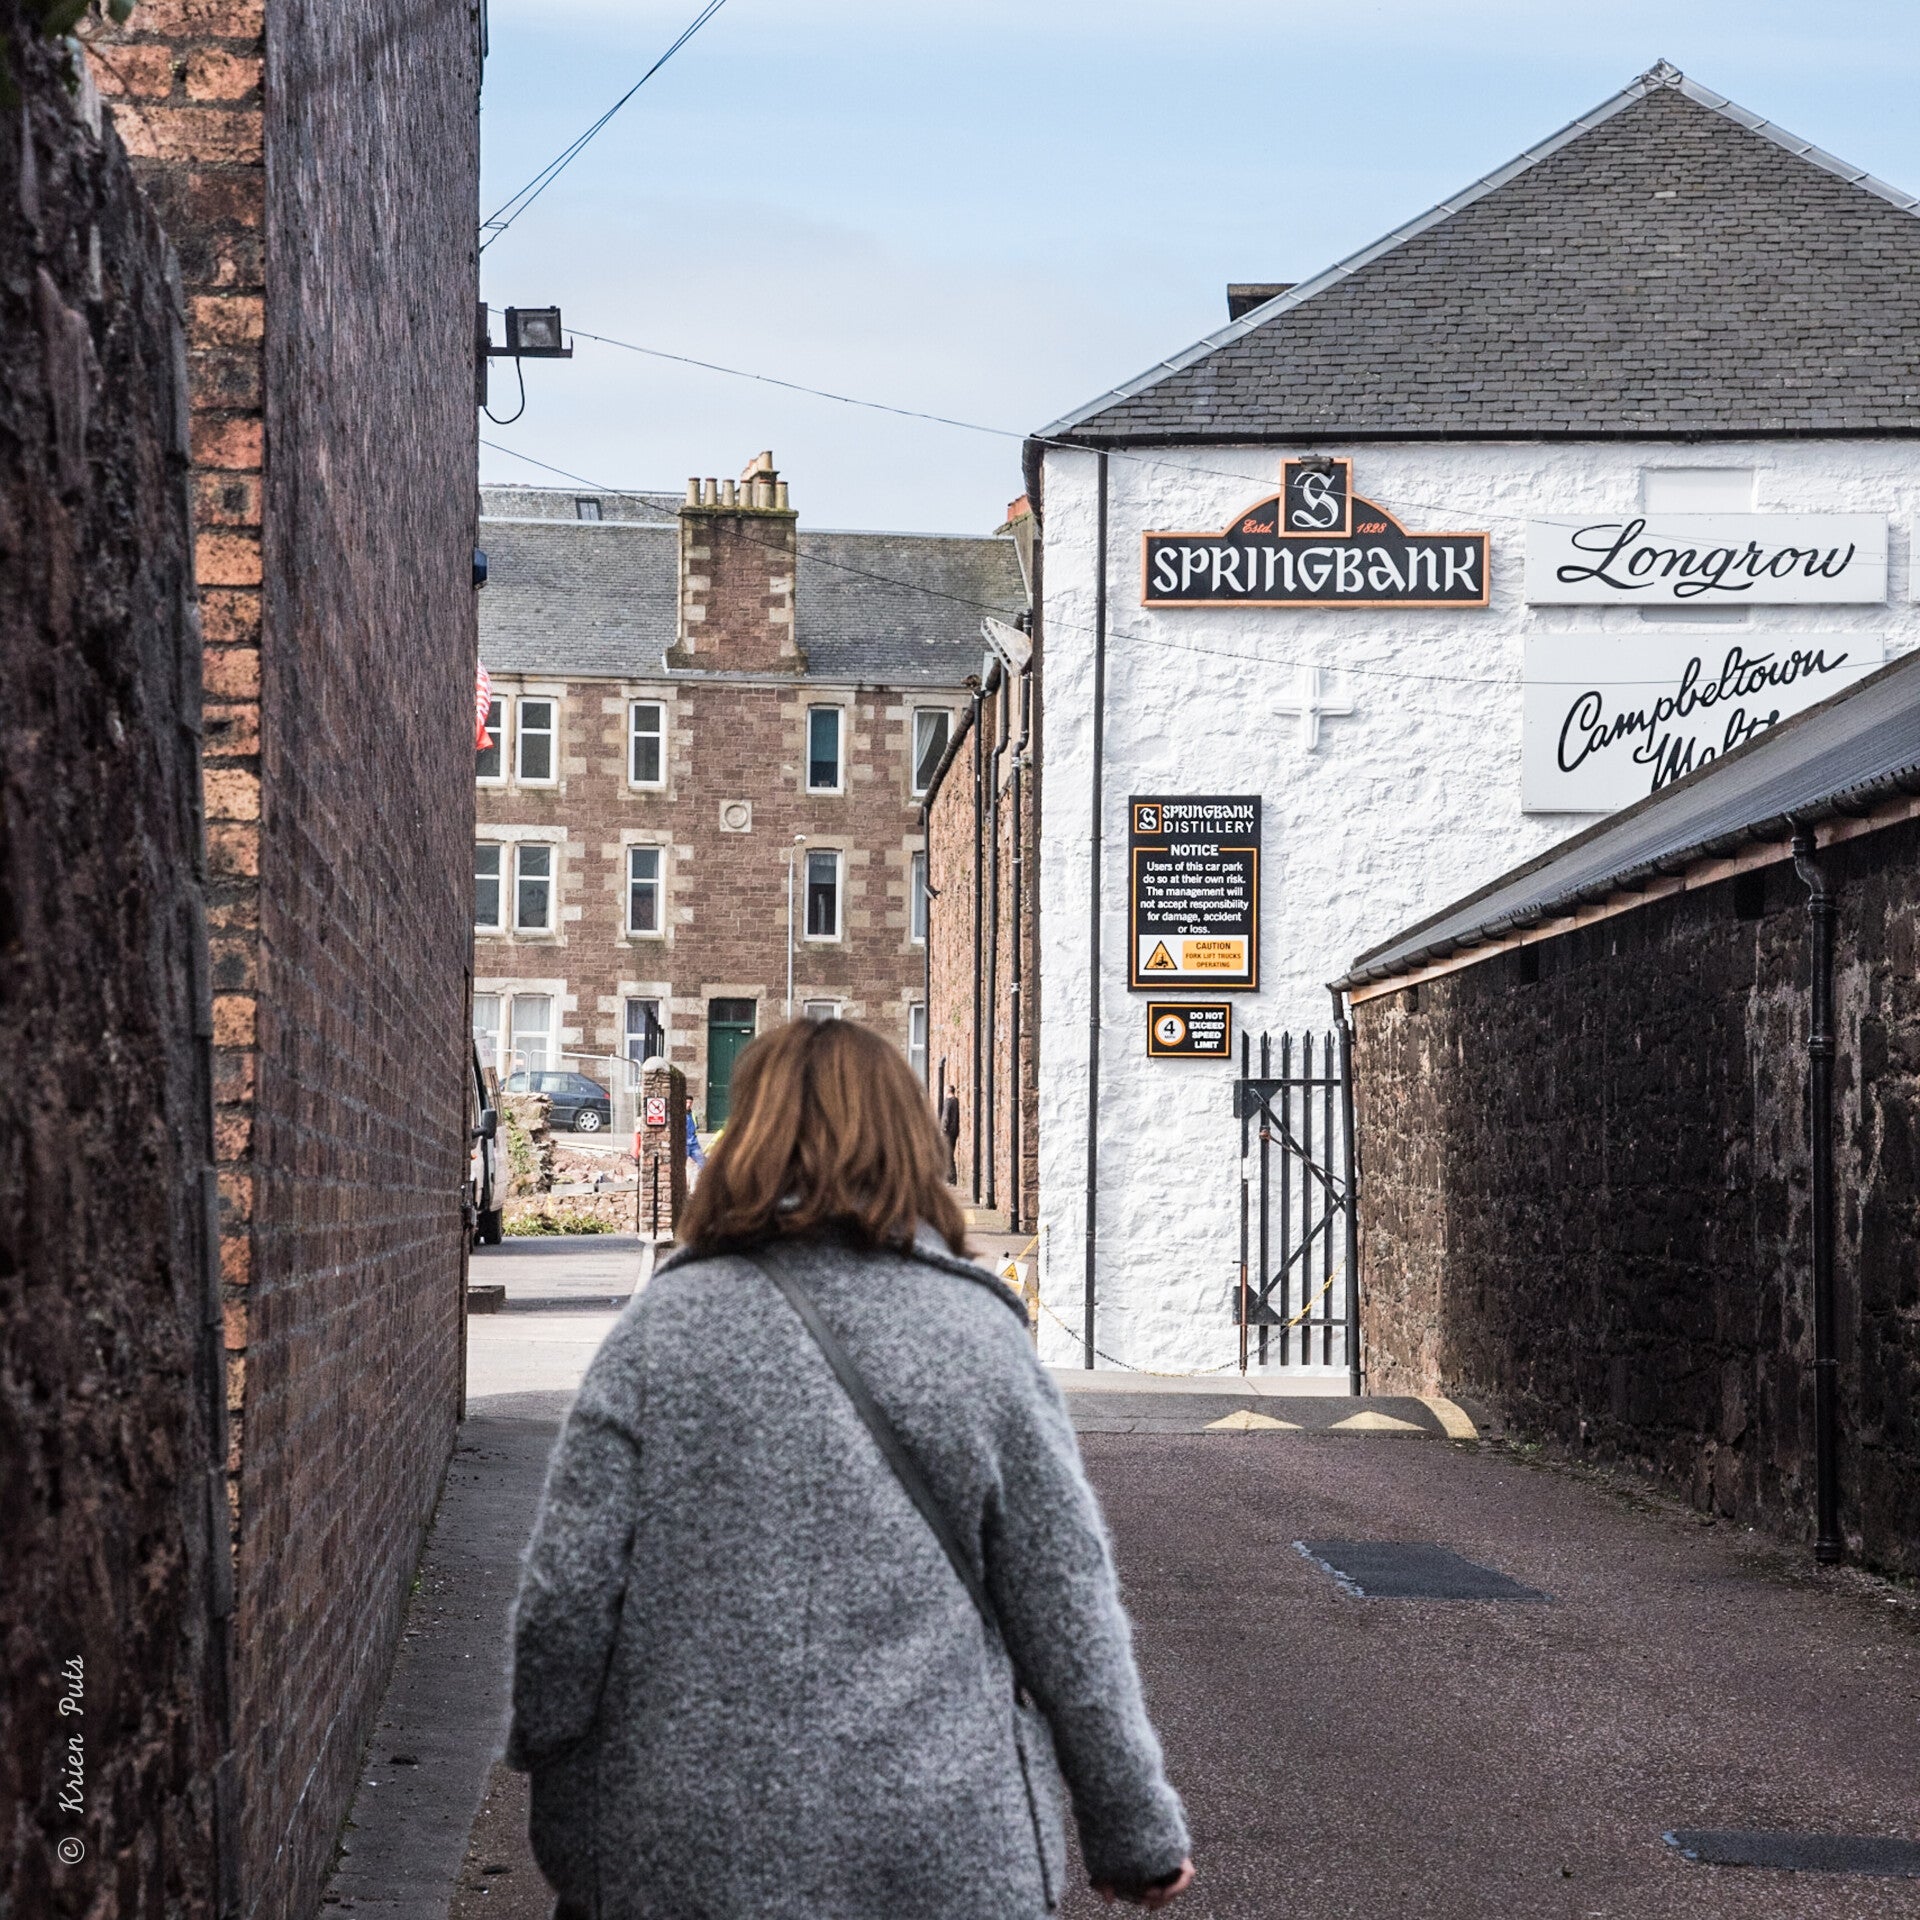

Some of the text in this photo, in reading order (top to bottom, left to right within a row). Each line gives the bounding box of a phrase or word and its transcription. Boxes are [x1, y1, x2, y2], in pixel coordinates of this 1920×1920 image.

[1291, 472, 1339, 528] S
[1242, 519, 1387, 534] Estd. 1828
[1556, 518, 1856, 598] Longrow
[1152, 545, 1479, 593] SPRINGBANK
[1557, 646, 1849, 773] Campbeltown
[1162, 805, 1254, 818] SPRINGBANK
[1163, 821, 1254, 833] DISTILLERY
[1170, 844, 1218, 856] NOTICE
[1146, 861, 1243, 873] Users of this car park
[1142, 874, 1246, 884] do so at their own risk.
[1146, 886, 1243, 898] The management will
[1140, 899, 1249, 911] not accept responsibility
[1147, 911, 1242, 922] for damage, accident
[1177, 924, 1211, 934] or loss.
[1195, 942, 1231, 950] CAUTION
[1189, 1012, 1224, 1020] DO NOT
[1164, 1020, 1175, 1034] 4
[1188, 1021, 1225, 1030] EXCEED
[1191, 1031, 1222, 1039] SPEED
[1194, 1041, 1219, 1049] LIMIT
